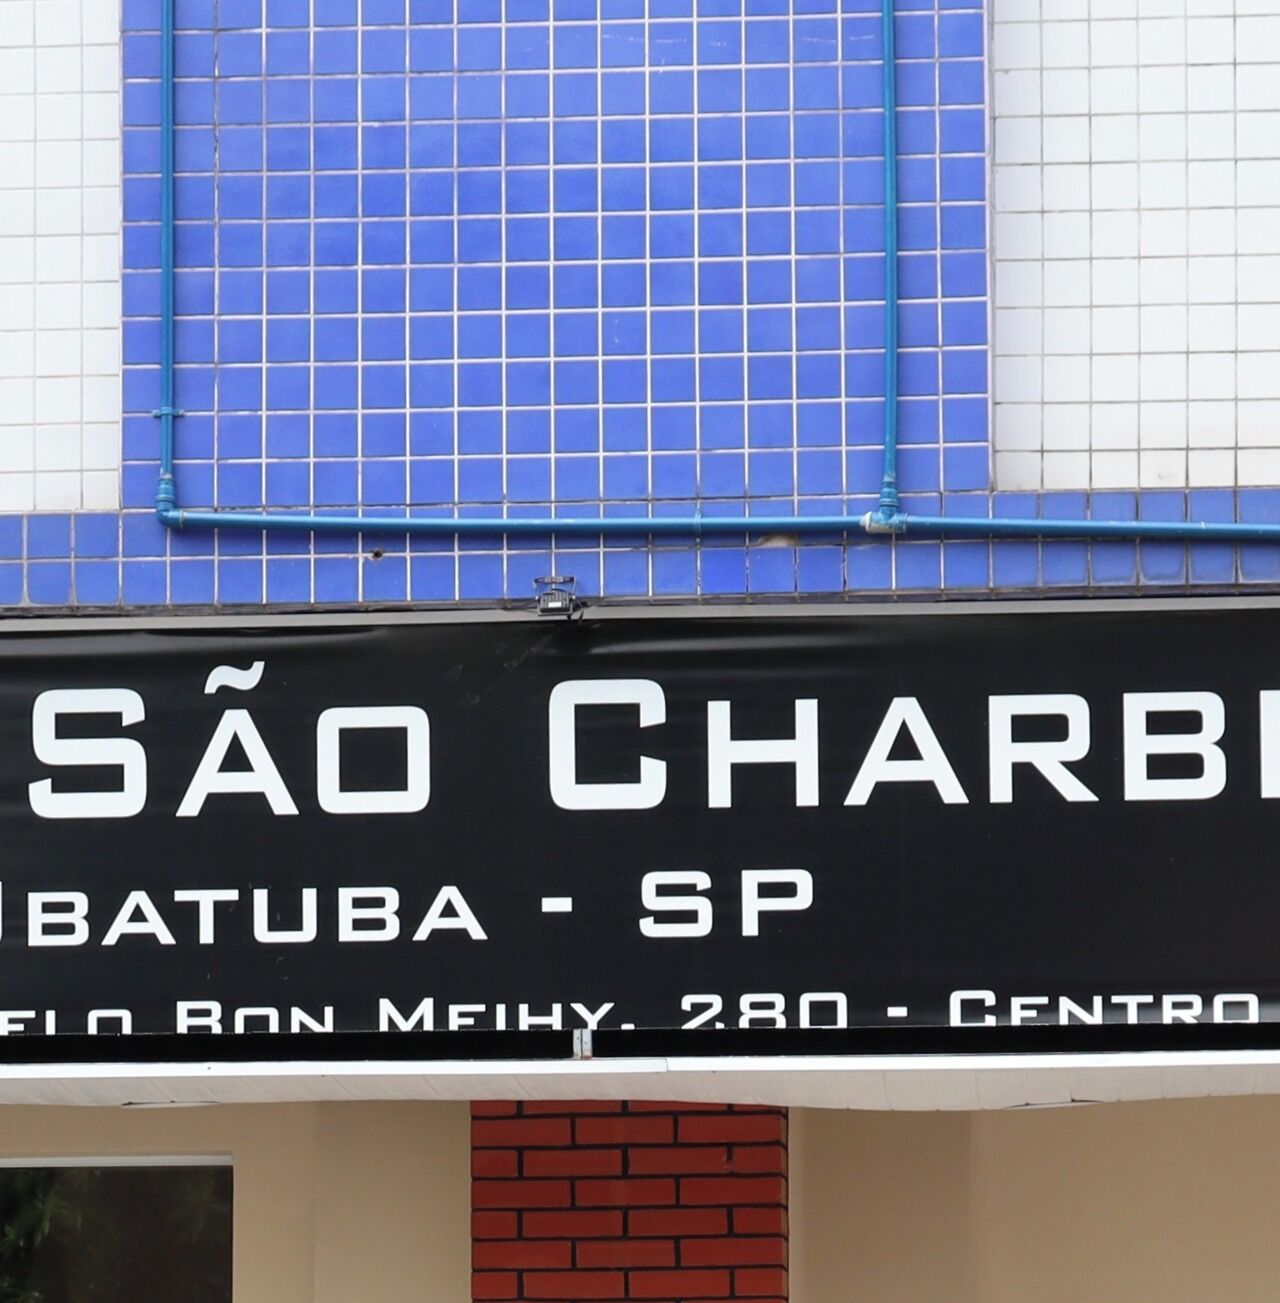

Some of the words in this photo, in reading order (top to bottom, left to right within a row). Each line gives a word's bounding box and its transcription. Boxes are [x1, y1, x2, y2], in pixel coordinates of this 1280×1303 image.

[28, 661, 431, 819] SÃO
[541, 897, 573, 913] -
[639, 868, 813, 938] SP
[887, 1006, 908, 1017] -
[949, 989, 1260, 1027] CENTRO
